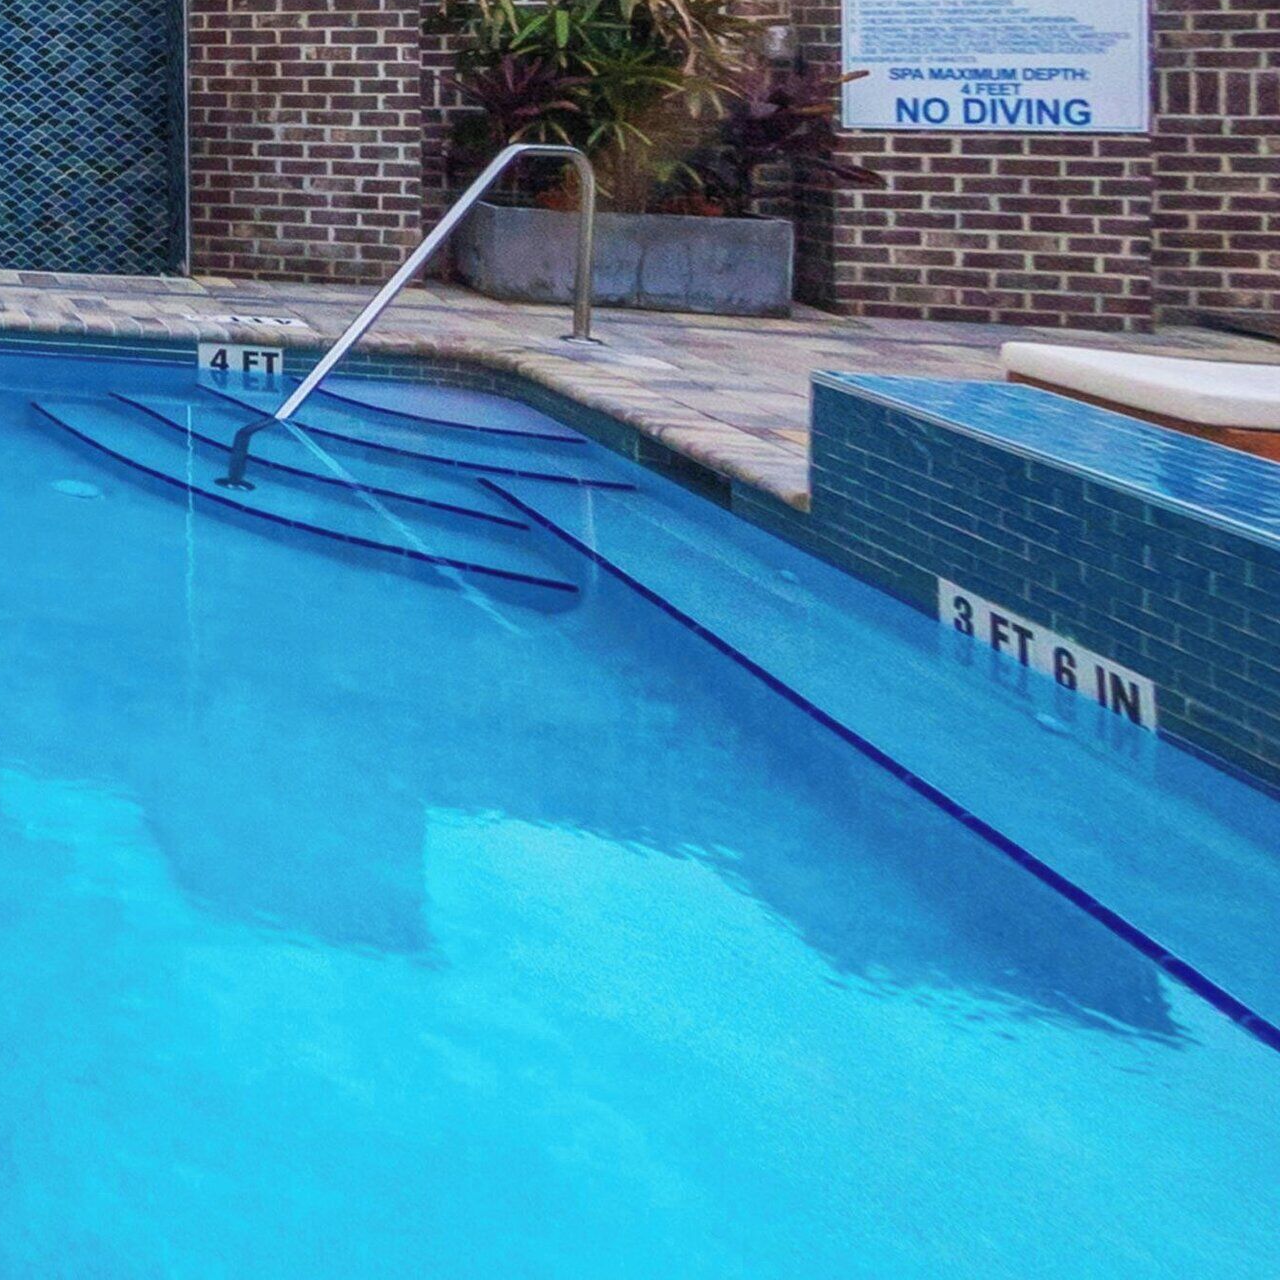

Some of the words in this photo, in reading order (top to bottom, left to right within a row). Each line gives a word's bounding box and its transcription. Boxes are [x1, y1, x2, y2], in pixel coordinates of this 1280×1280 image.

[888, 68, 923, 80] SPA
[929, 68, 1018, 80] MAXIMUM
[1023, 68, 1090, 80] DEPTH:
[960, 83, 971, 95] 4
[975, 83, 1022, 96] FEET
[895, 97, 950, 124] NO
[963, 98, 1092, 126] DIVING
[210, 348, 229, 370] 4
[243, 351, 280, 374] FT
[952, 595, 974, 637] 3
[989, 611, 1035, 667] FT
[1053, 646, 1077, 691] 6
[1094, 664, 1142, 726] IN
